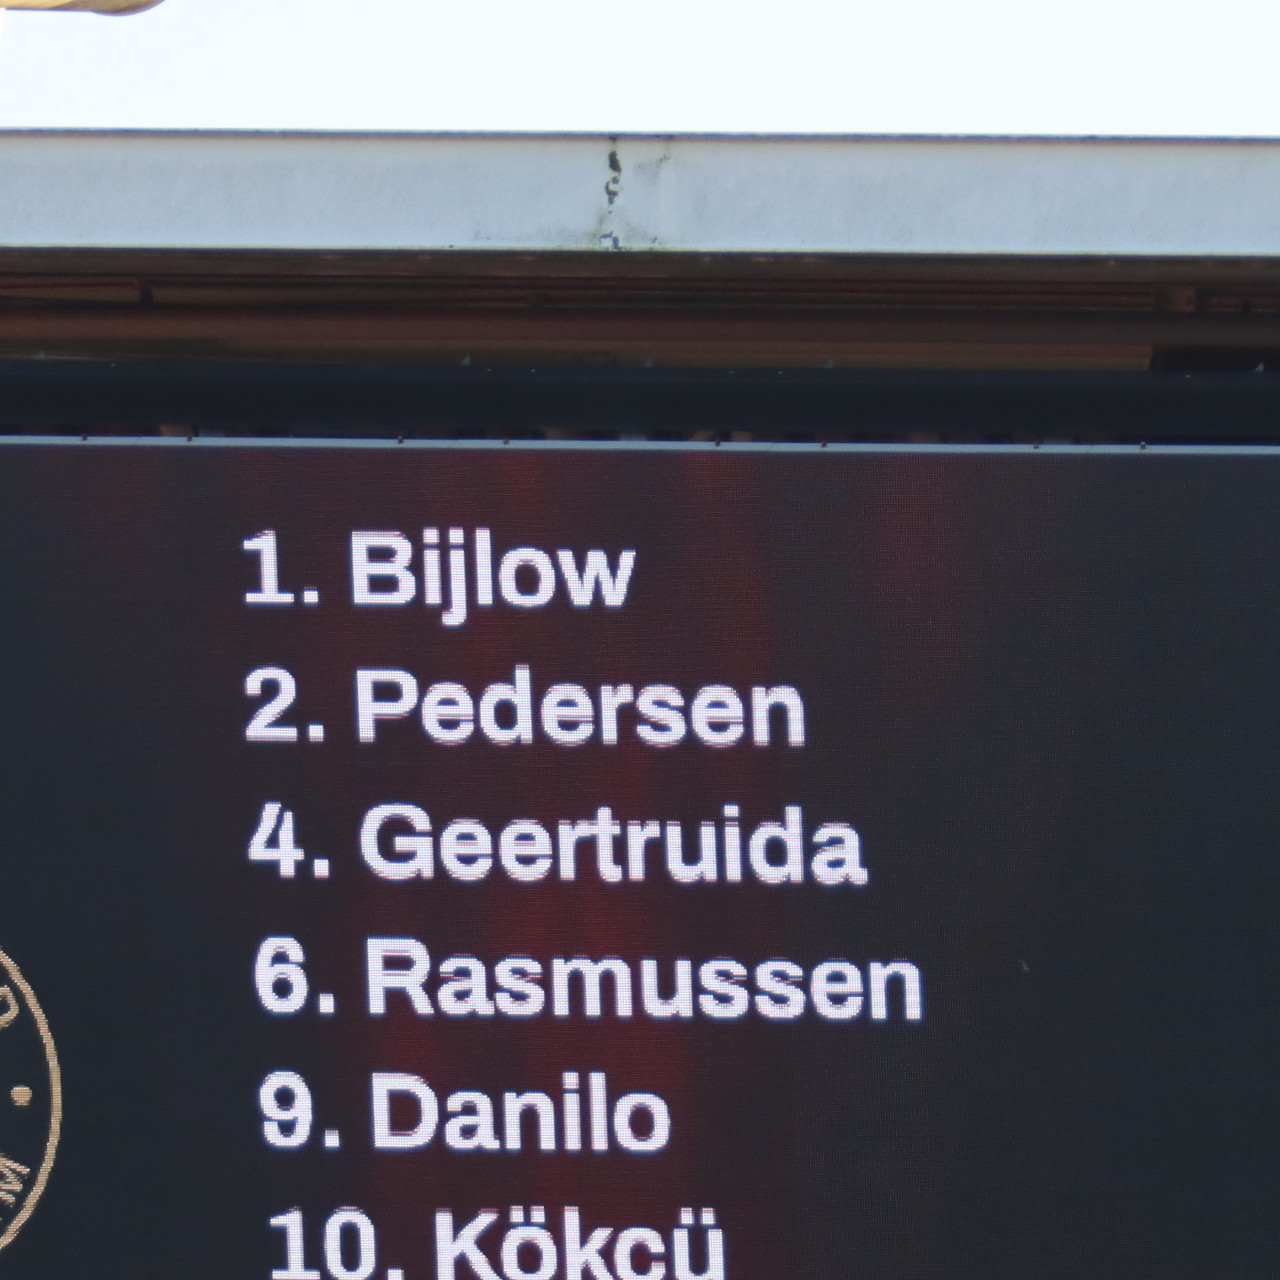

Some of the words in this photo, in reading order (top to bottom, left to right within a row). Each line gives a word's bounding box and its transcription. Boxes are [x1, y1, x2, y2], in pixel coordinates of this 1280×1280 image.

[242, 529, 320, 604] 1.
[350, 527, 636, 626] Bijlow
[244, 666, 324, 742] 2.
[355, 663, 806, 748] Pedersen
[247, 802, 329, 878] 4.
[359, 803, 869, 886] Geertruida
[254, 936, 335, 1014] 6.
[366, 937, 922, 1020] Rasmussen
[258, 1070, 340, 1149] 9.
[370, 1071, 671, 1152] Danilo
